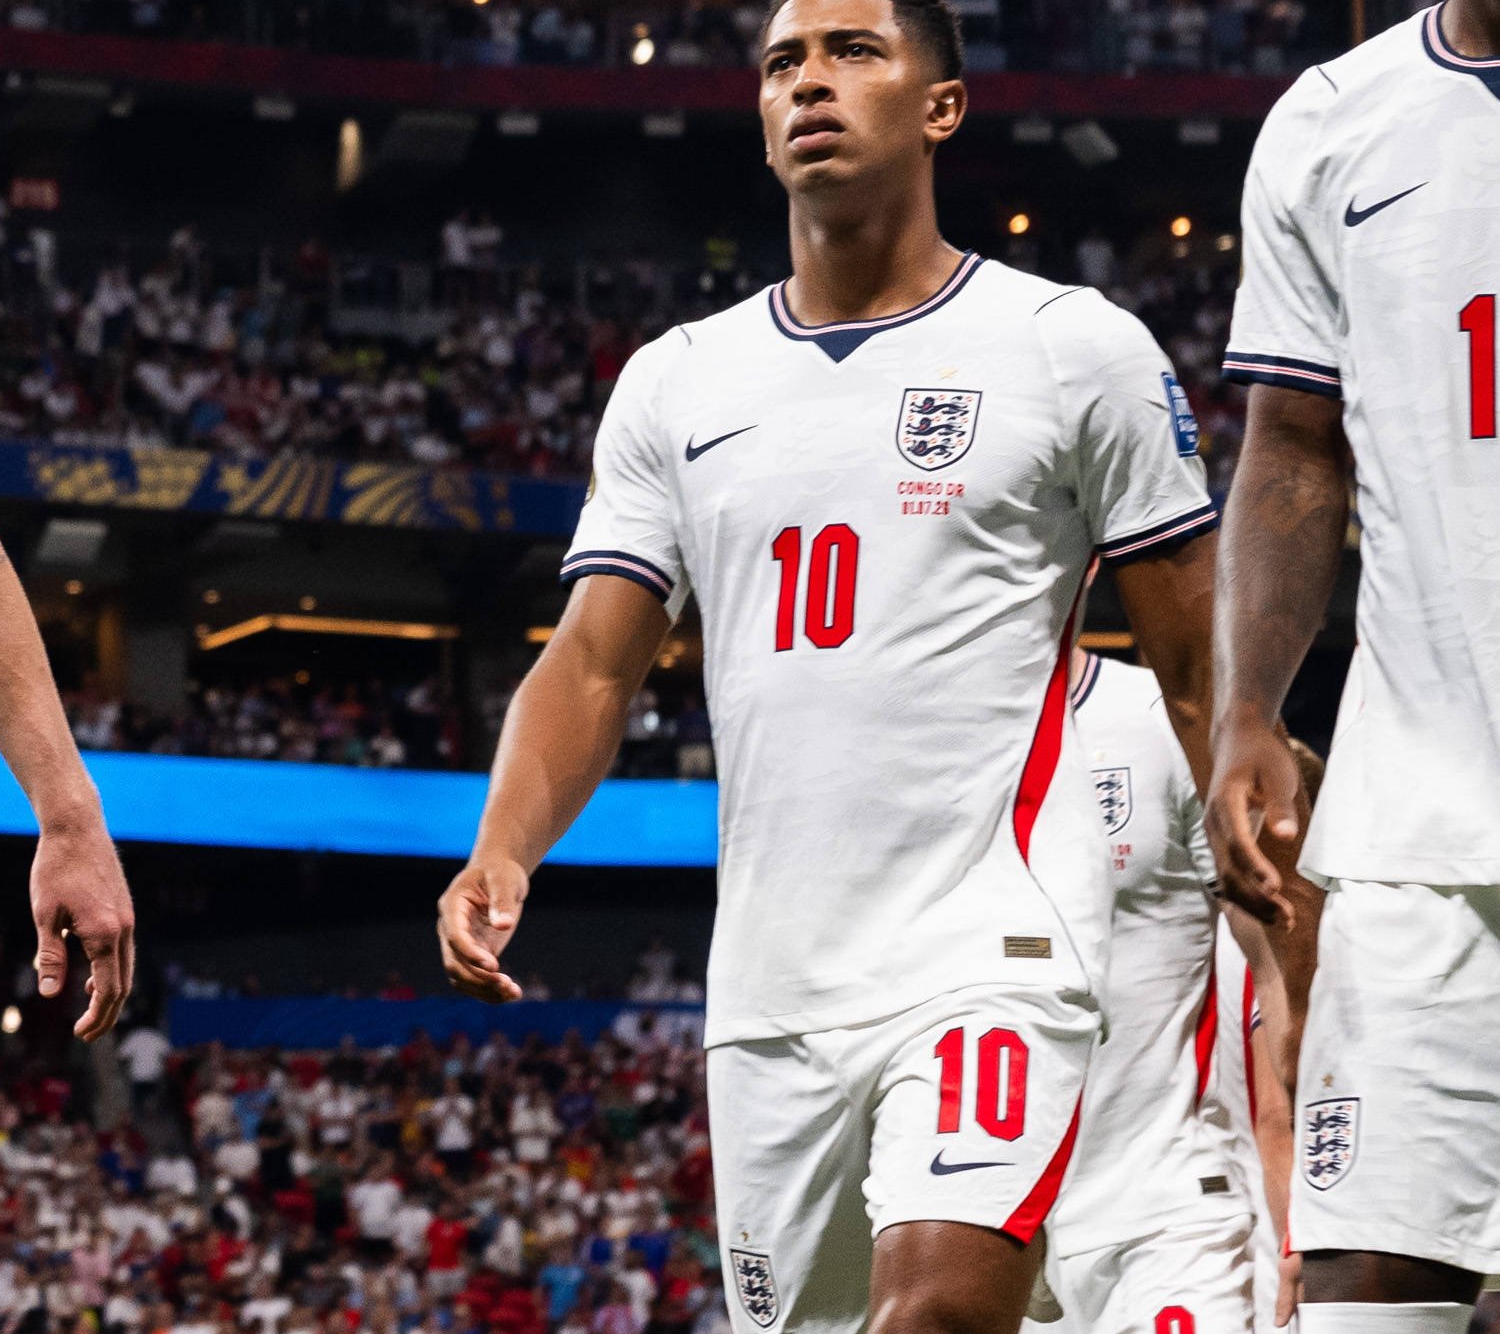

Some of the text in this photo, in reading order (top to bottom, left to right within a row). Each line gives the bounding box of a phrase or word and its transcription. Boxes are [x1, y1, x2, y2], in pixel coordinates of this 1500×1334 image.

[897, 480, 965, 499] CONGO DR
[771, 522, 861, 653] 10
[933, 1026, 1031, 1143] 10
